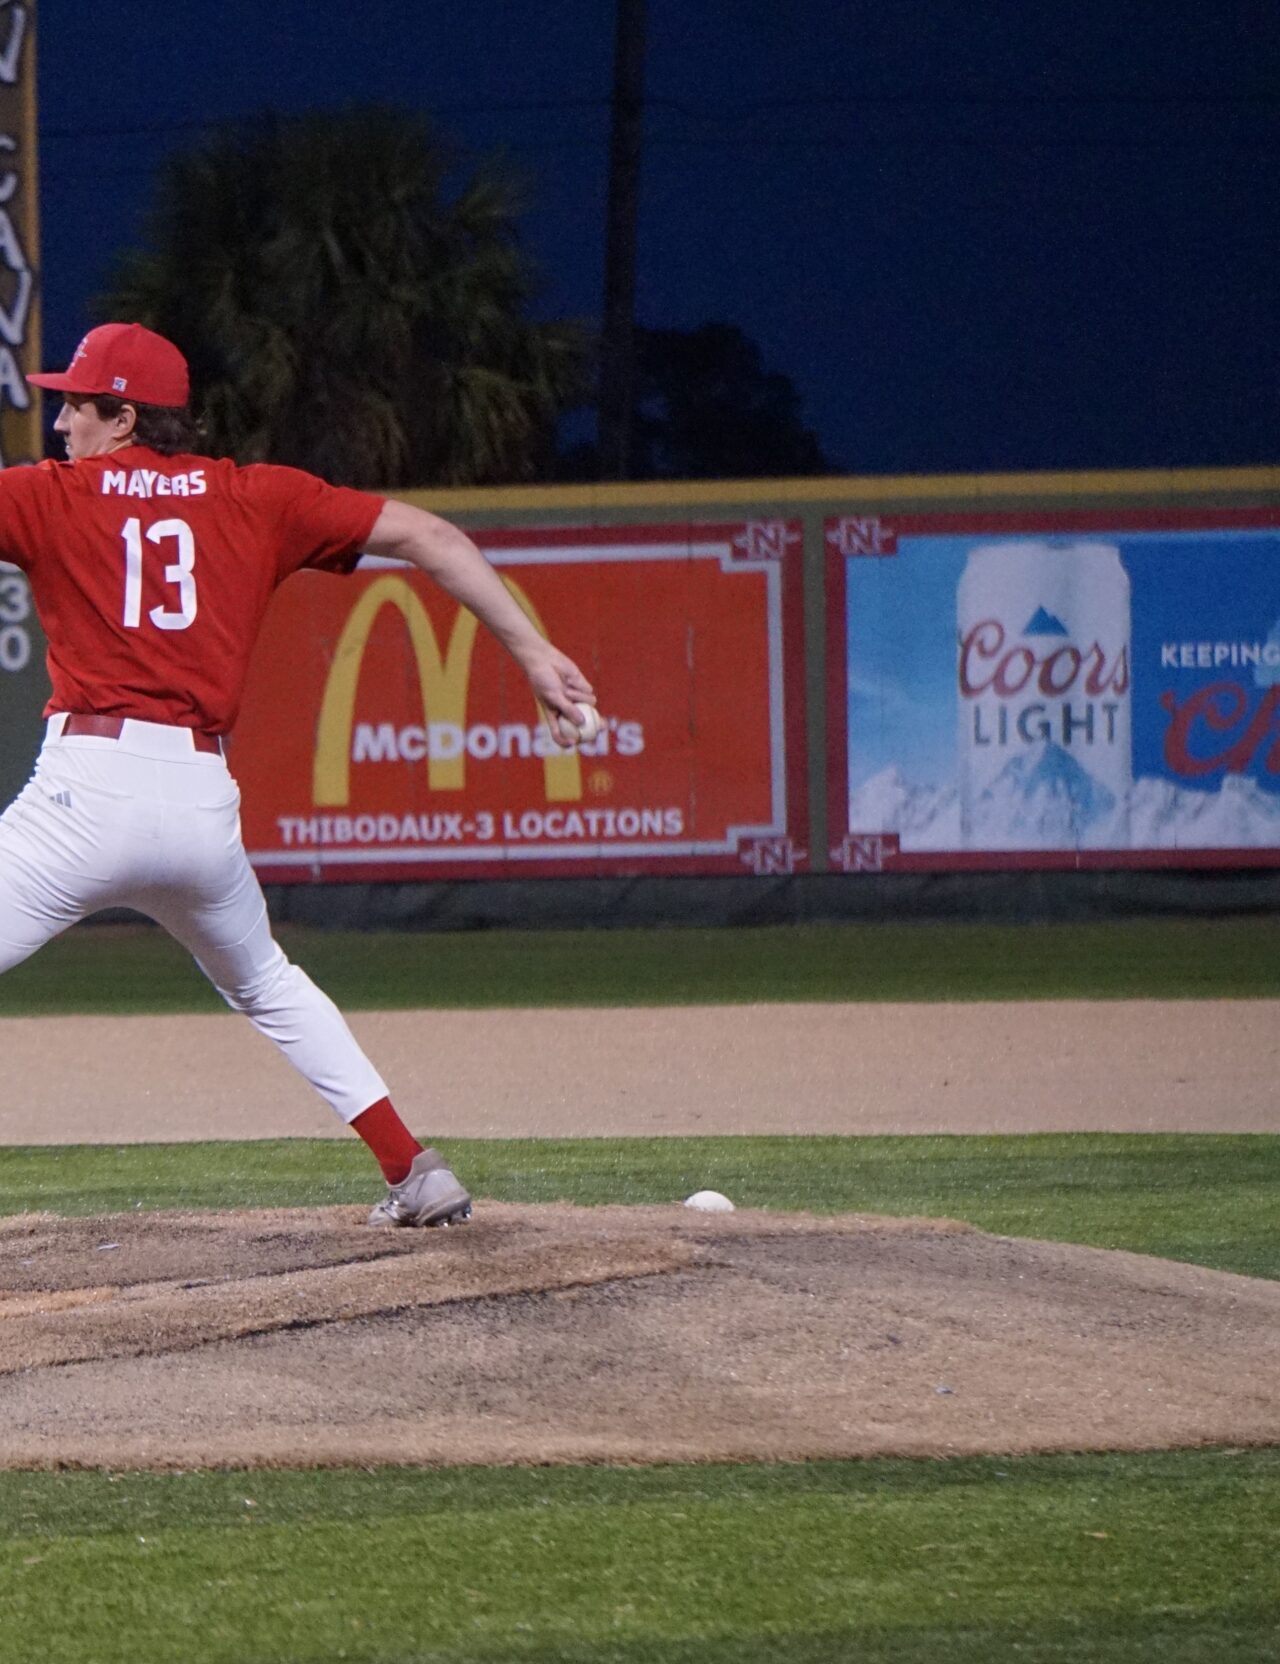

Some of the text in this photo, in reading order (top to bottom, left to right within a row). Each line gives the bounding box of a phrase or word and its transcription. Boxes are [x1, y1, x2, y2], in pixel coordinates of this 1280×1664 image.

[101, 468, 207, 498] MAYERS
[121, 517, 198, 630] 13
[958, 618, 1130, 699] Coors
[974, 702, 1119, 746] LIGHT
[277, 808, 685, 845] THIBODAUX-3 LOCATIONS
